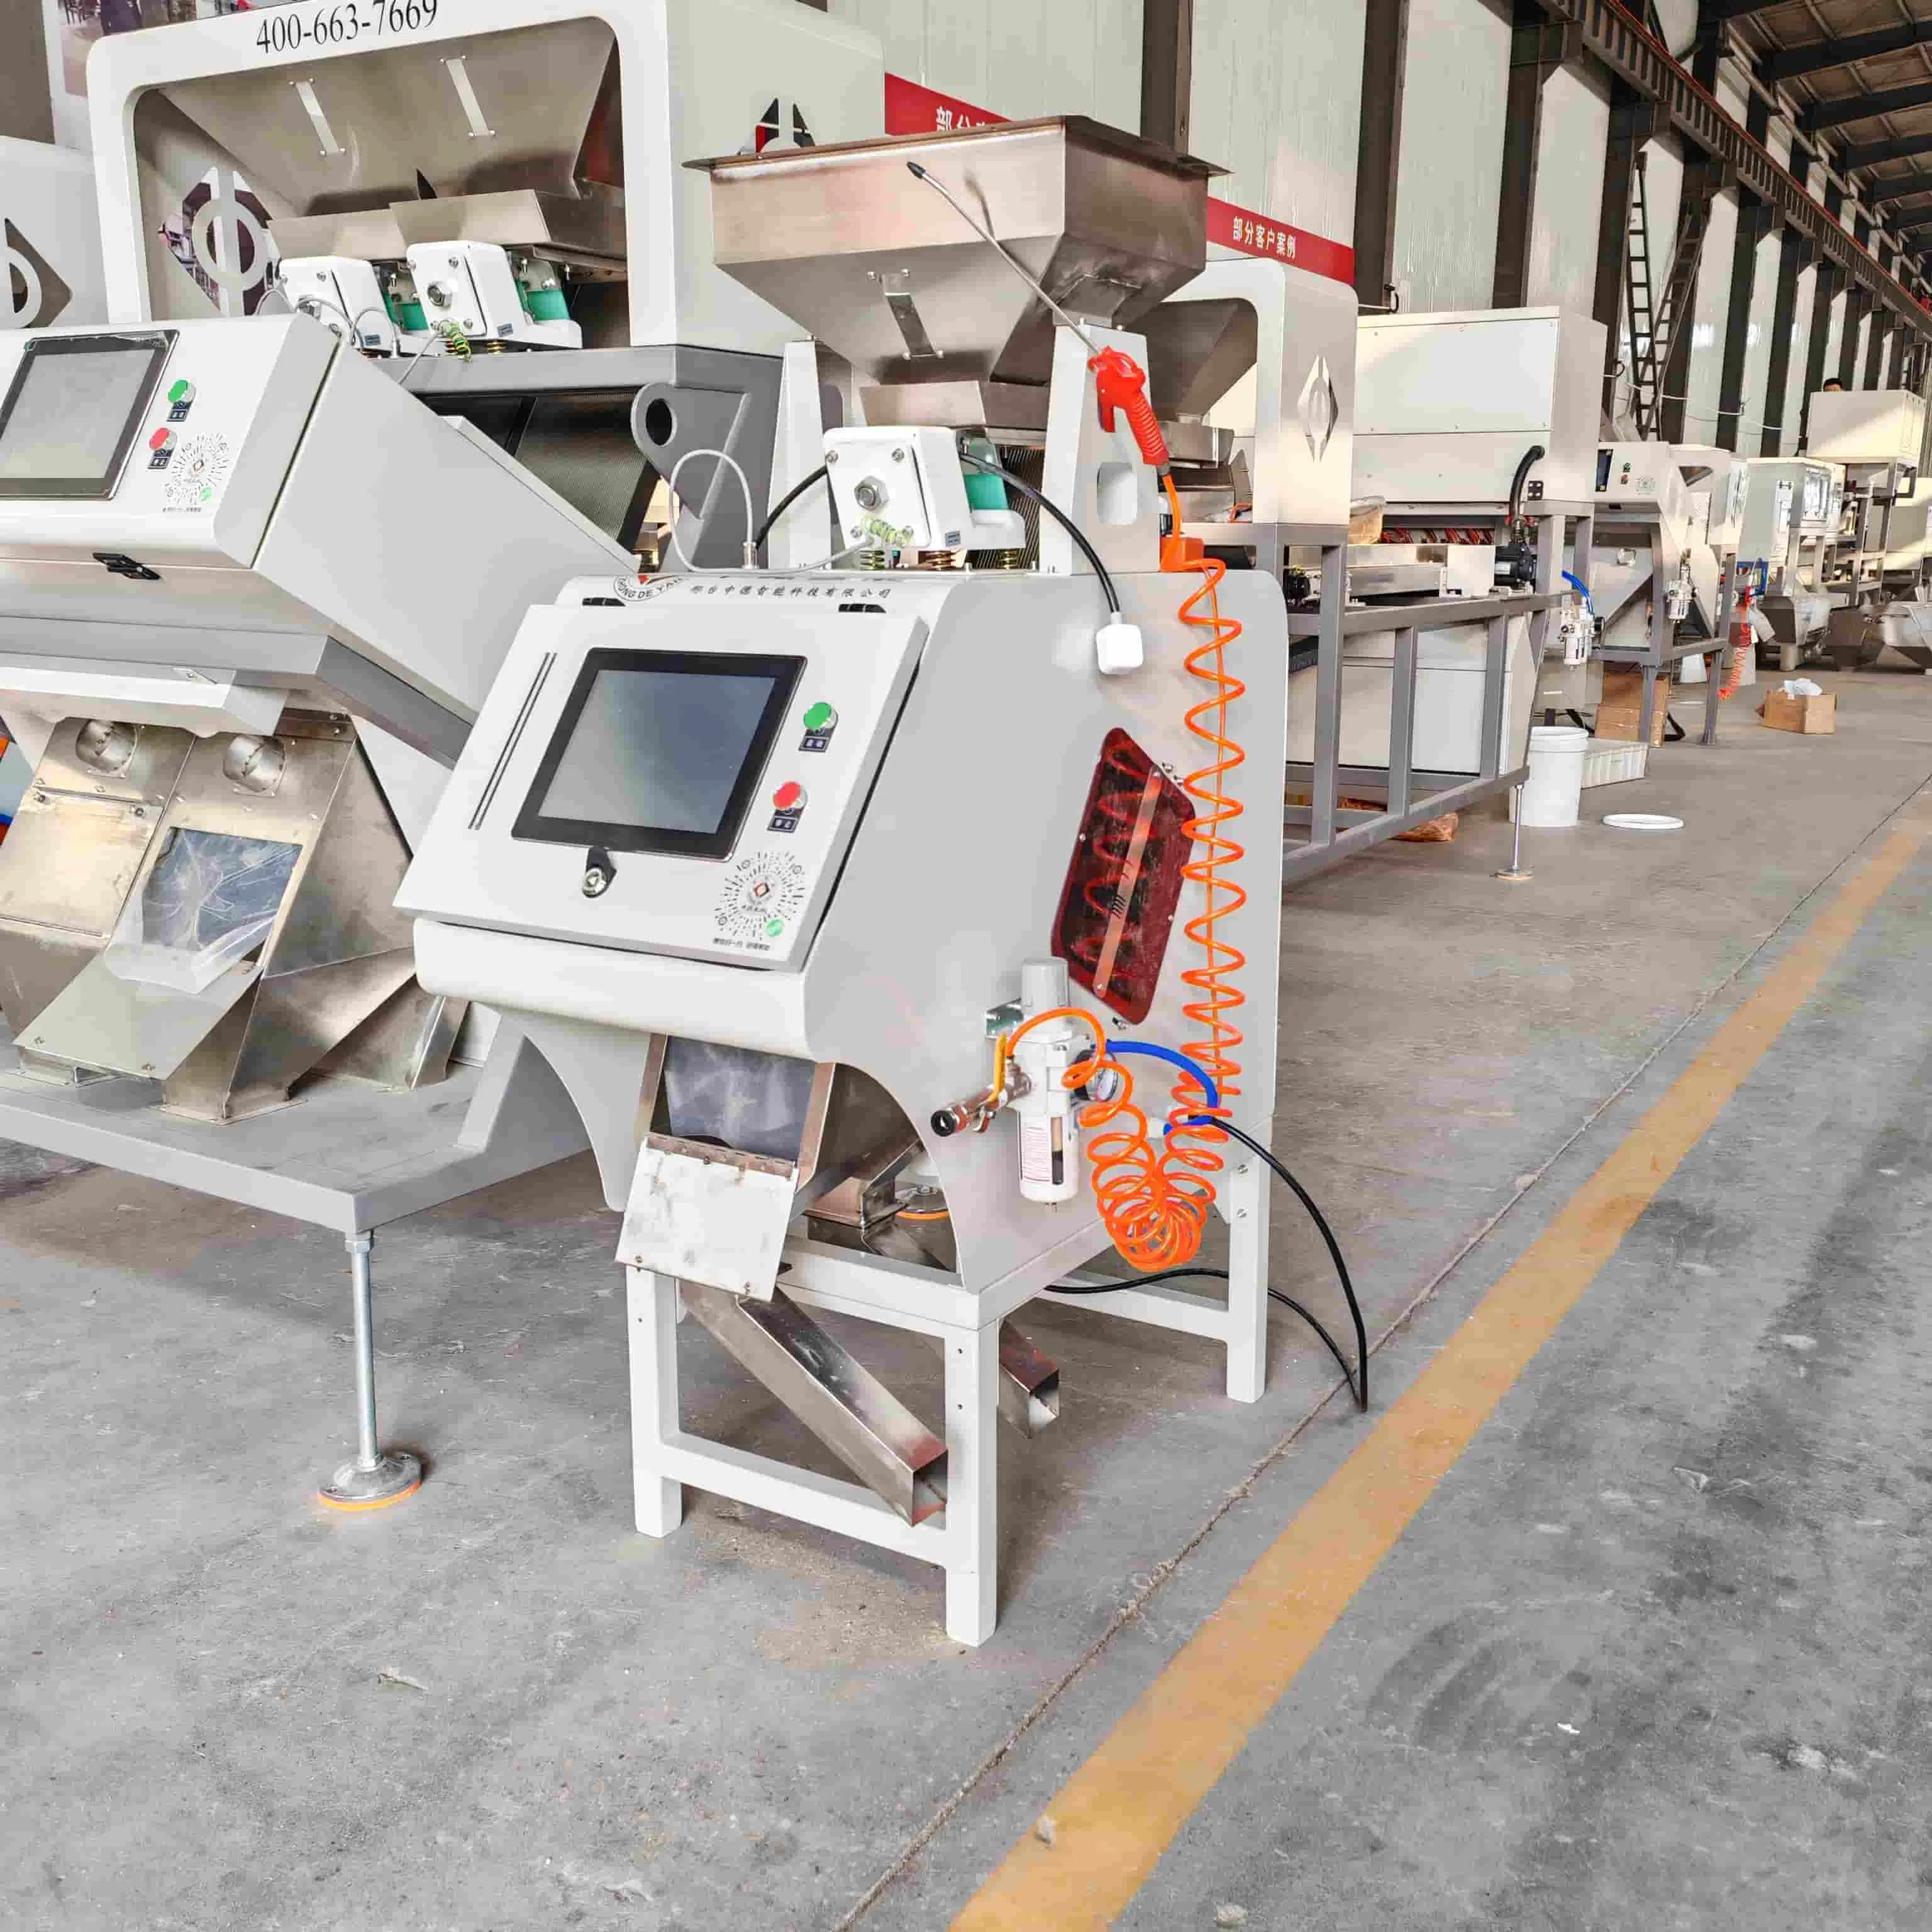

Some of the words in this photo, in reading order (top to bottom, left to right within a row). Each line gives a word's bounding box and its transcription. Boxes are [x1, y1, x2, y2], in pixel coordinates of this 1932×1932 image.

[257, 0, 437, 53] 400-663-7669
[1233, 216, 1296, 259] 部分客户案例
